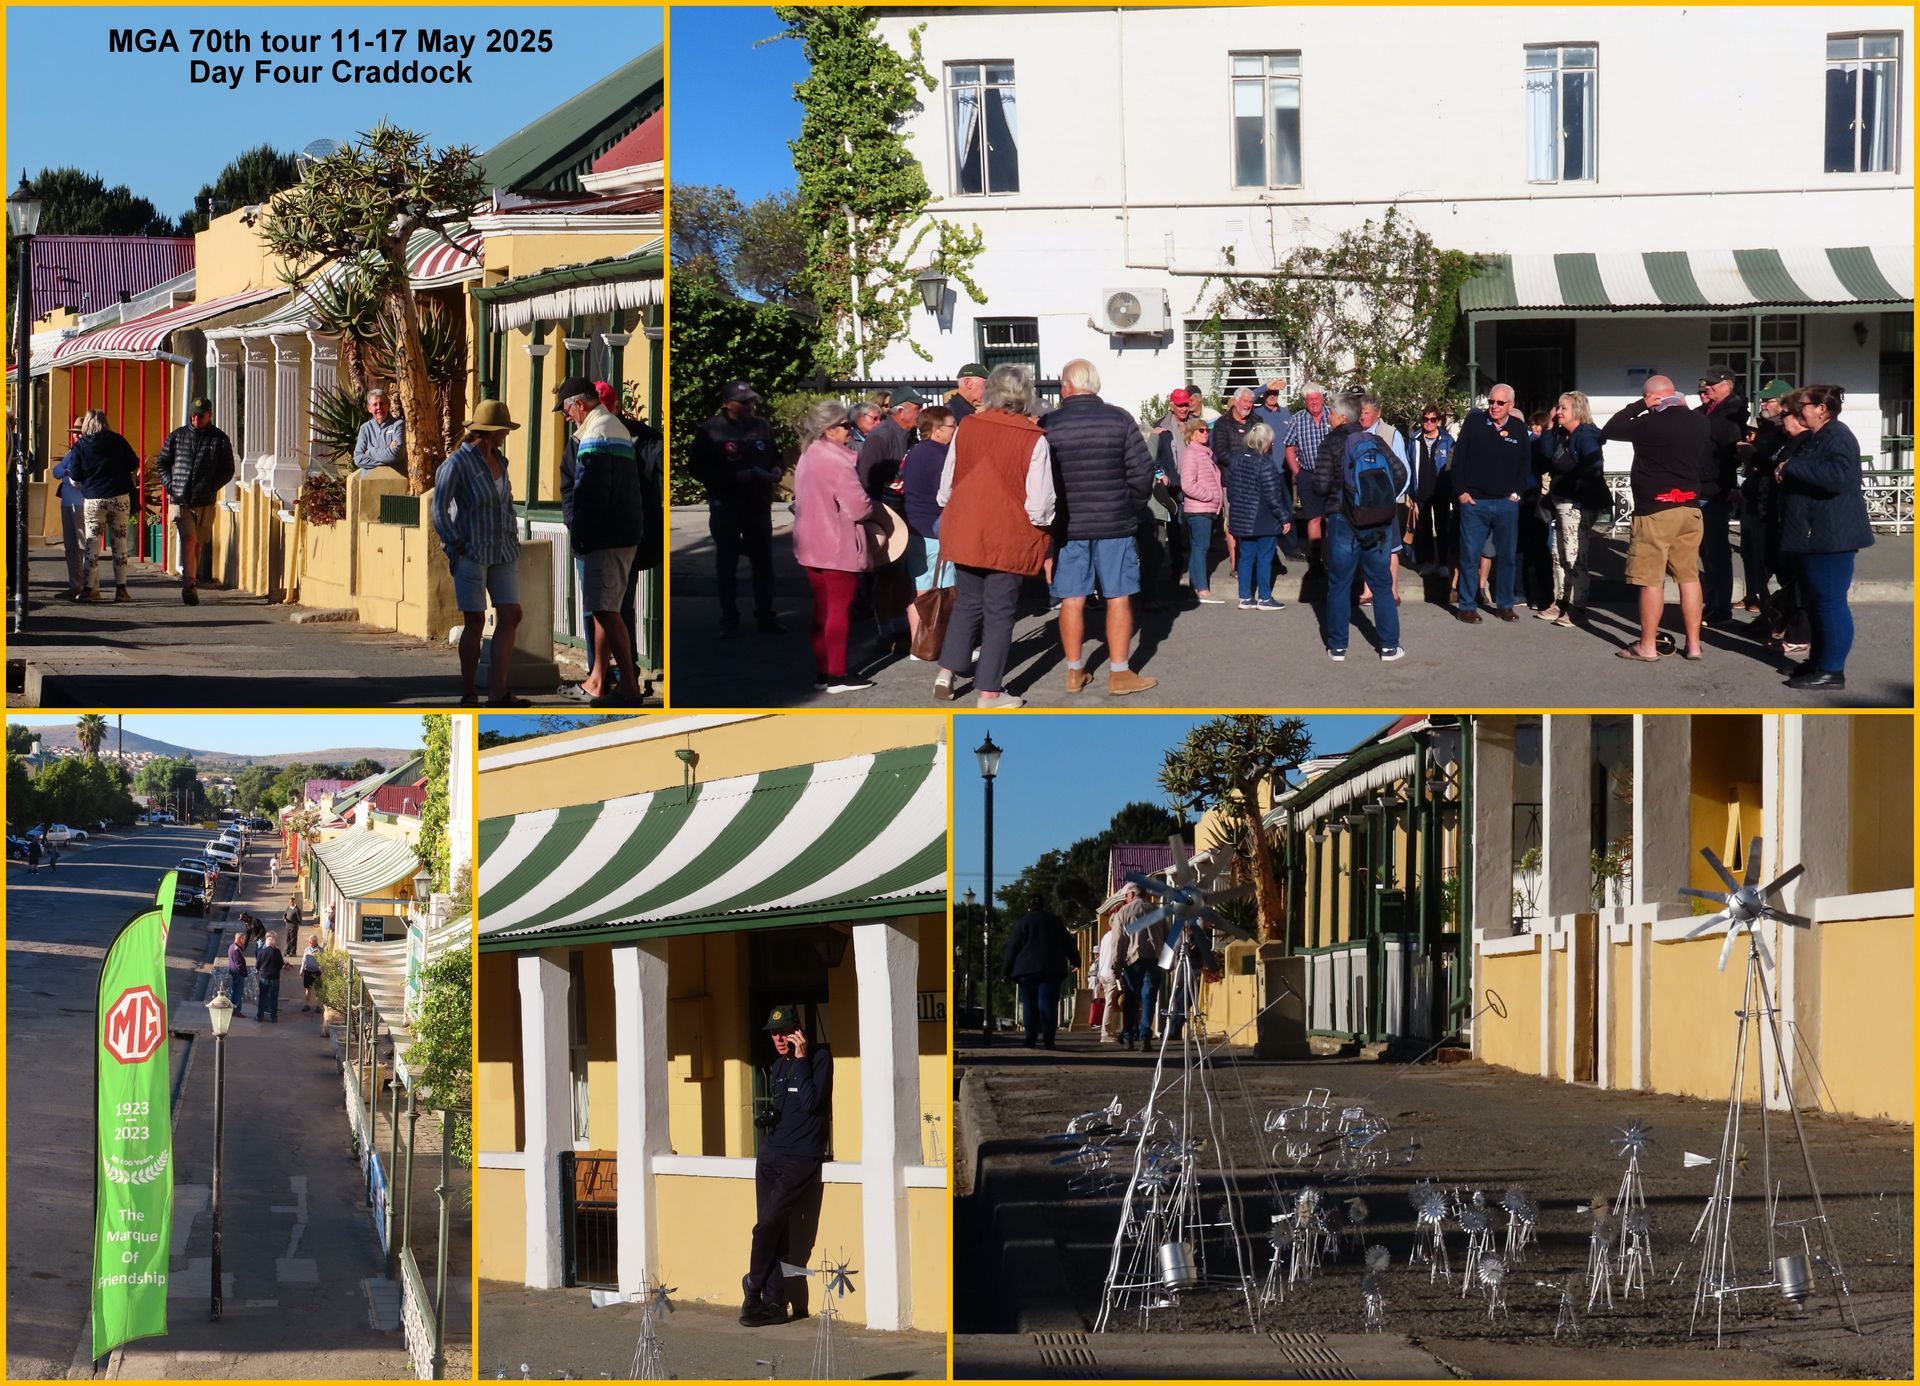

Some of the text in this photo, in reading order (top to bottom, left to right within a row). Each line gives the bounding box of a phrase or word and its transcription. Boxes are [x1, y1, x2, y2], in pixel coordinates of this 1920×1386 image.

[112, 994, 159, 1055] MG
[115, 1101, 150, 1117] 1923
[114, 1126, 150, 1141] 2023
[134, 1154, 154, 1166] Years
[118, 1208, 145, 1222] The
[106, 1230, 159, 1245] Marque
[121, 1251, 139, 1264] Of
[98, 1271, 166, 1290] Friendship
